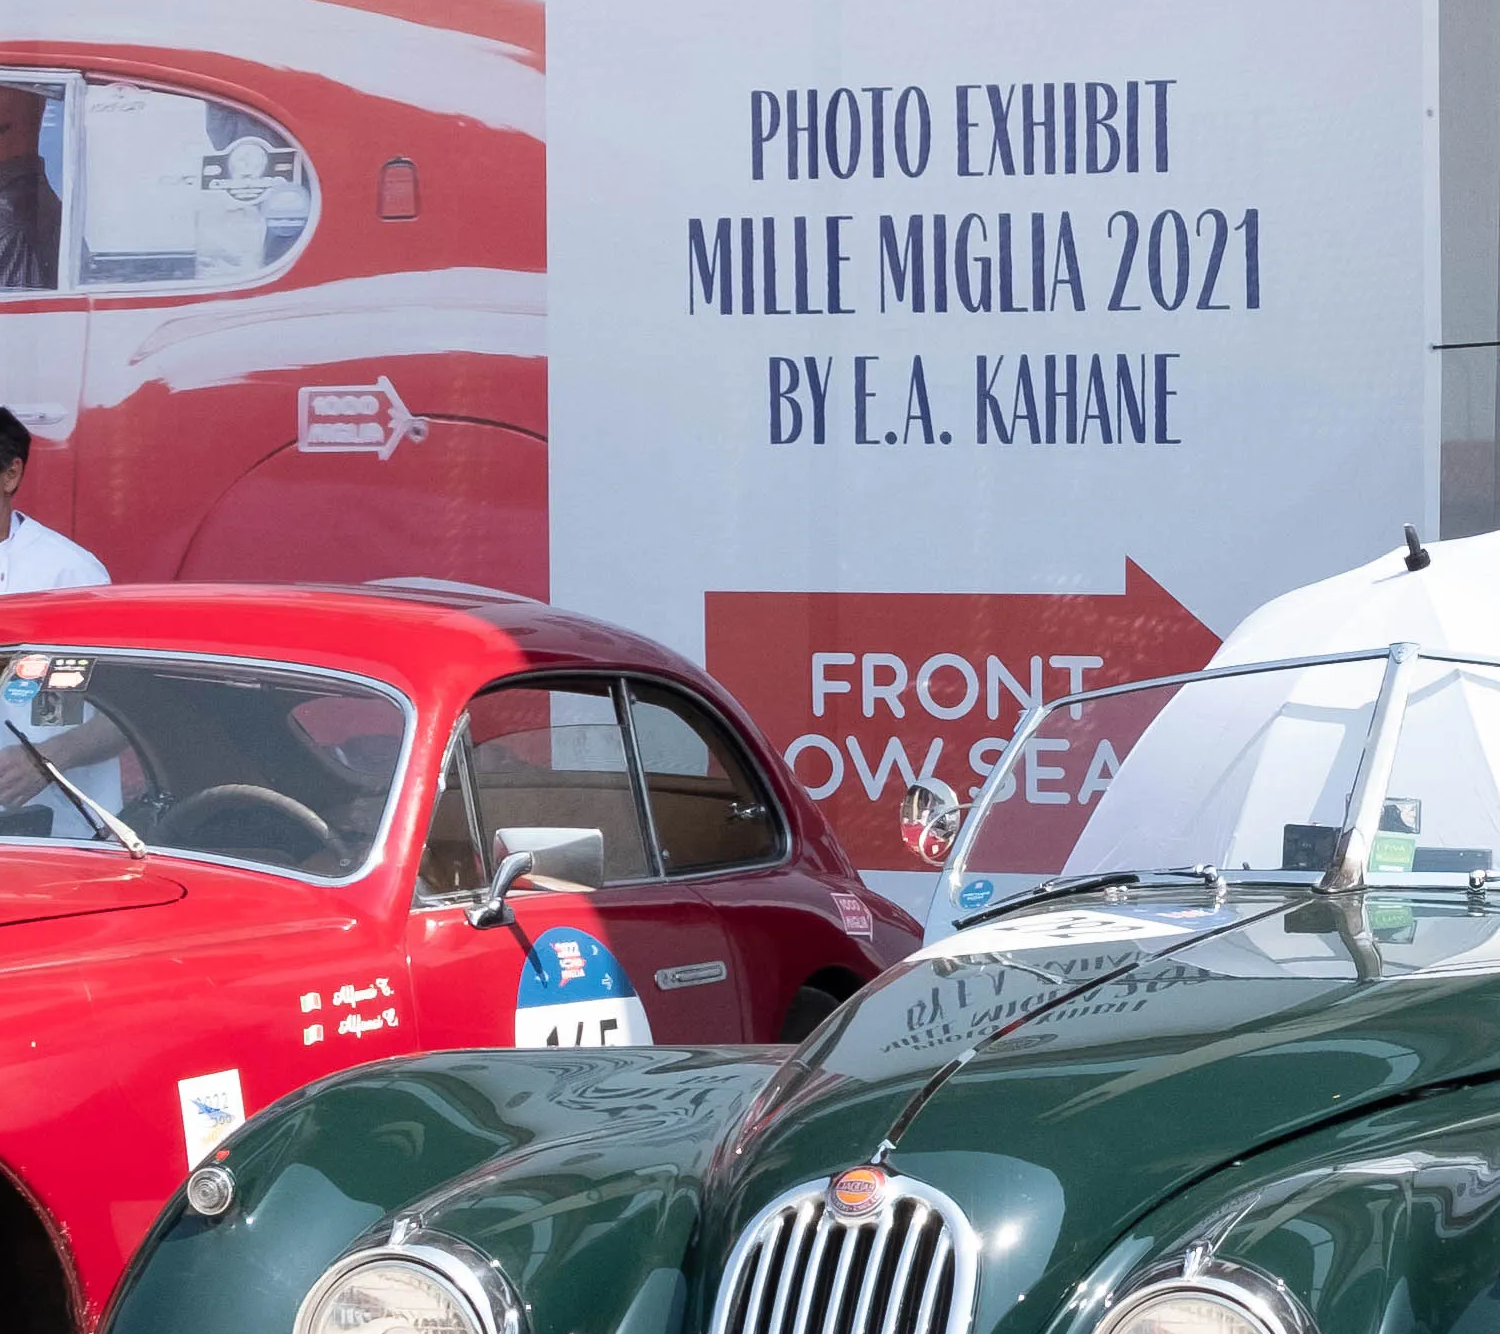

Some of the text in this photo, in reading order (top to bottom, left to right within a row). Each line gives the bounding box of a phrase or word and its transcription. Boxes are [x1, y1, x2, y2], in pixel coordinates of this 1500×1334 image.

[750, 79, 1177, 180] PHOTO EXHIBIT
[689, 207, 1261, 316] MILLE MIGLIA 2021
[769, 352, 1182, 444] BY E.A. KAHANE
[811, 652, 1104, 721] FRONT
